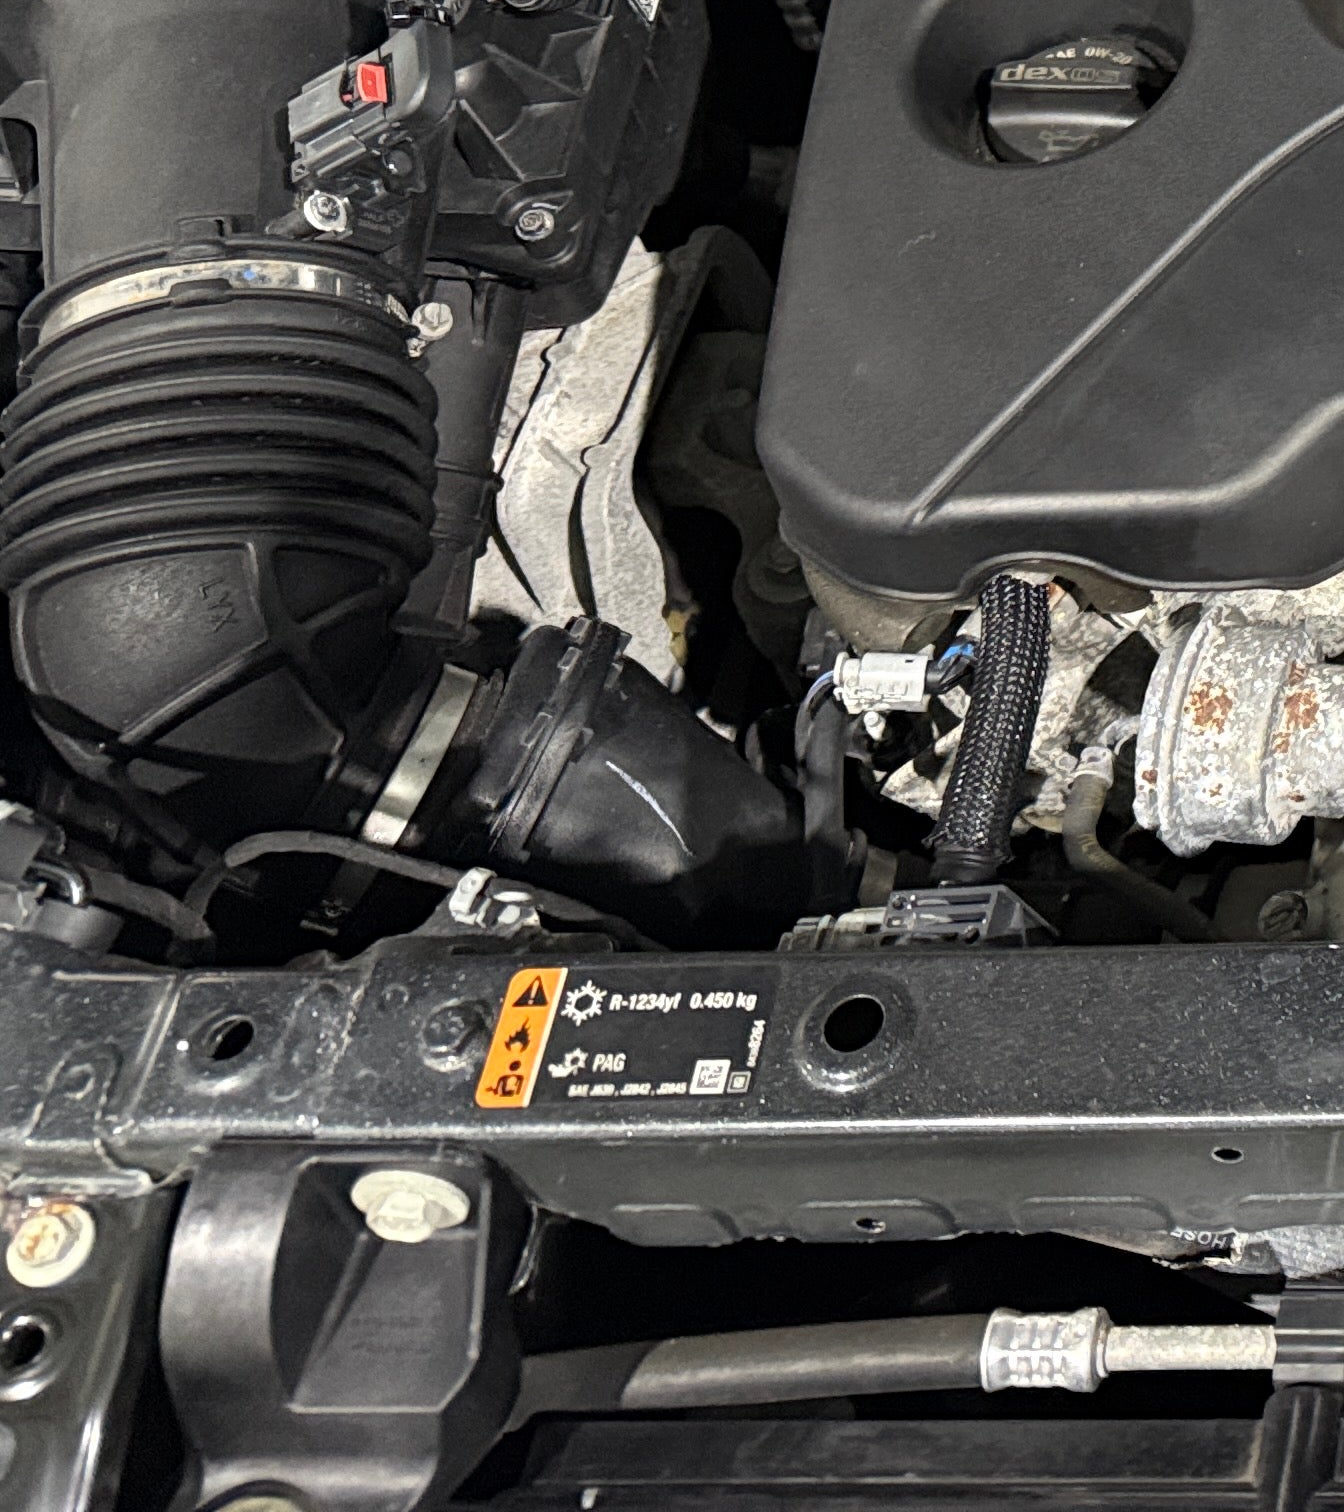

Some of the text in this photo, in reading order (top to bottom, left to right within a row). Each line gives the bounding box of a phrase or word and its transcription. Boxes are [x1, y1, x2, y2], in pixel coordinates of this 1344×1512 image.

[1000, 63, 1121, 84] dexos
[608, 992, 758, 1013] R-1234yf 0.450 kg
[592, 1053, 627, 1073] PAG
